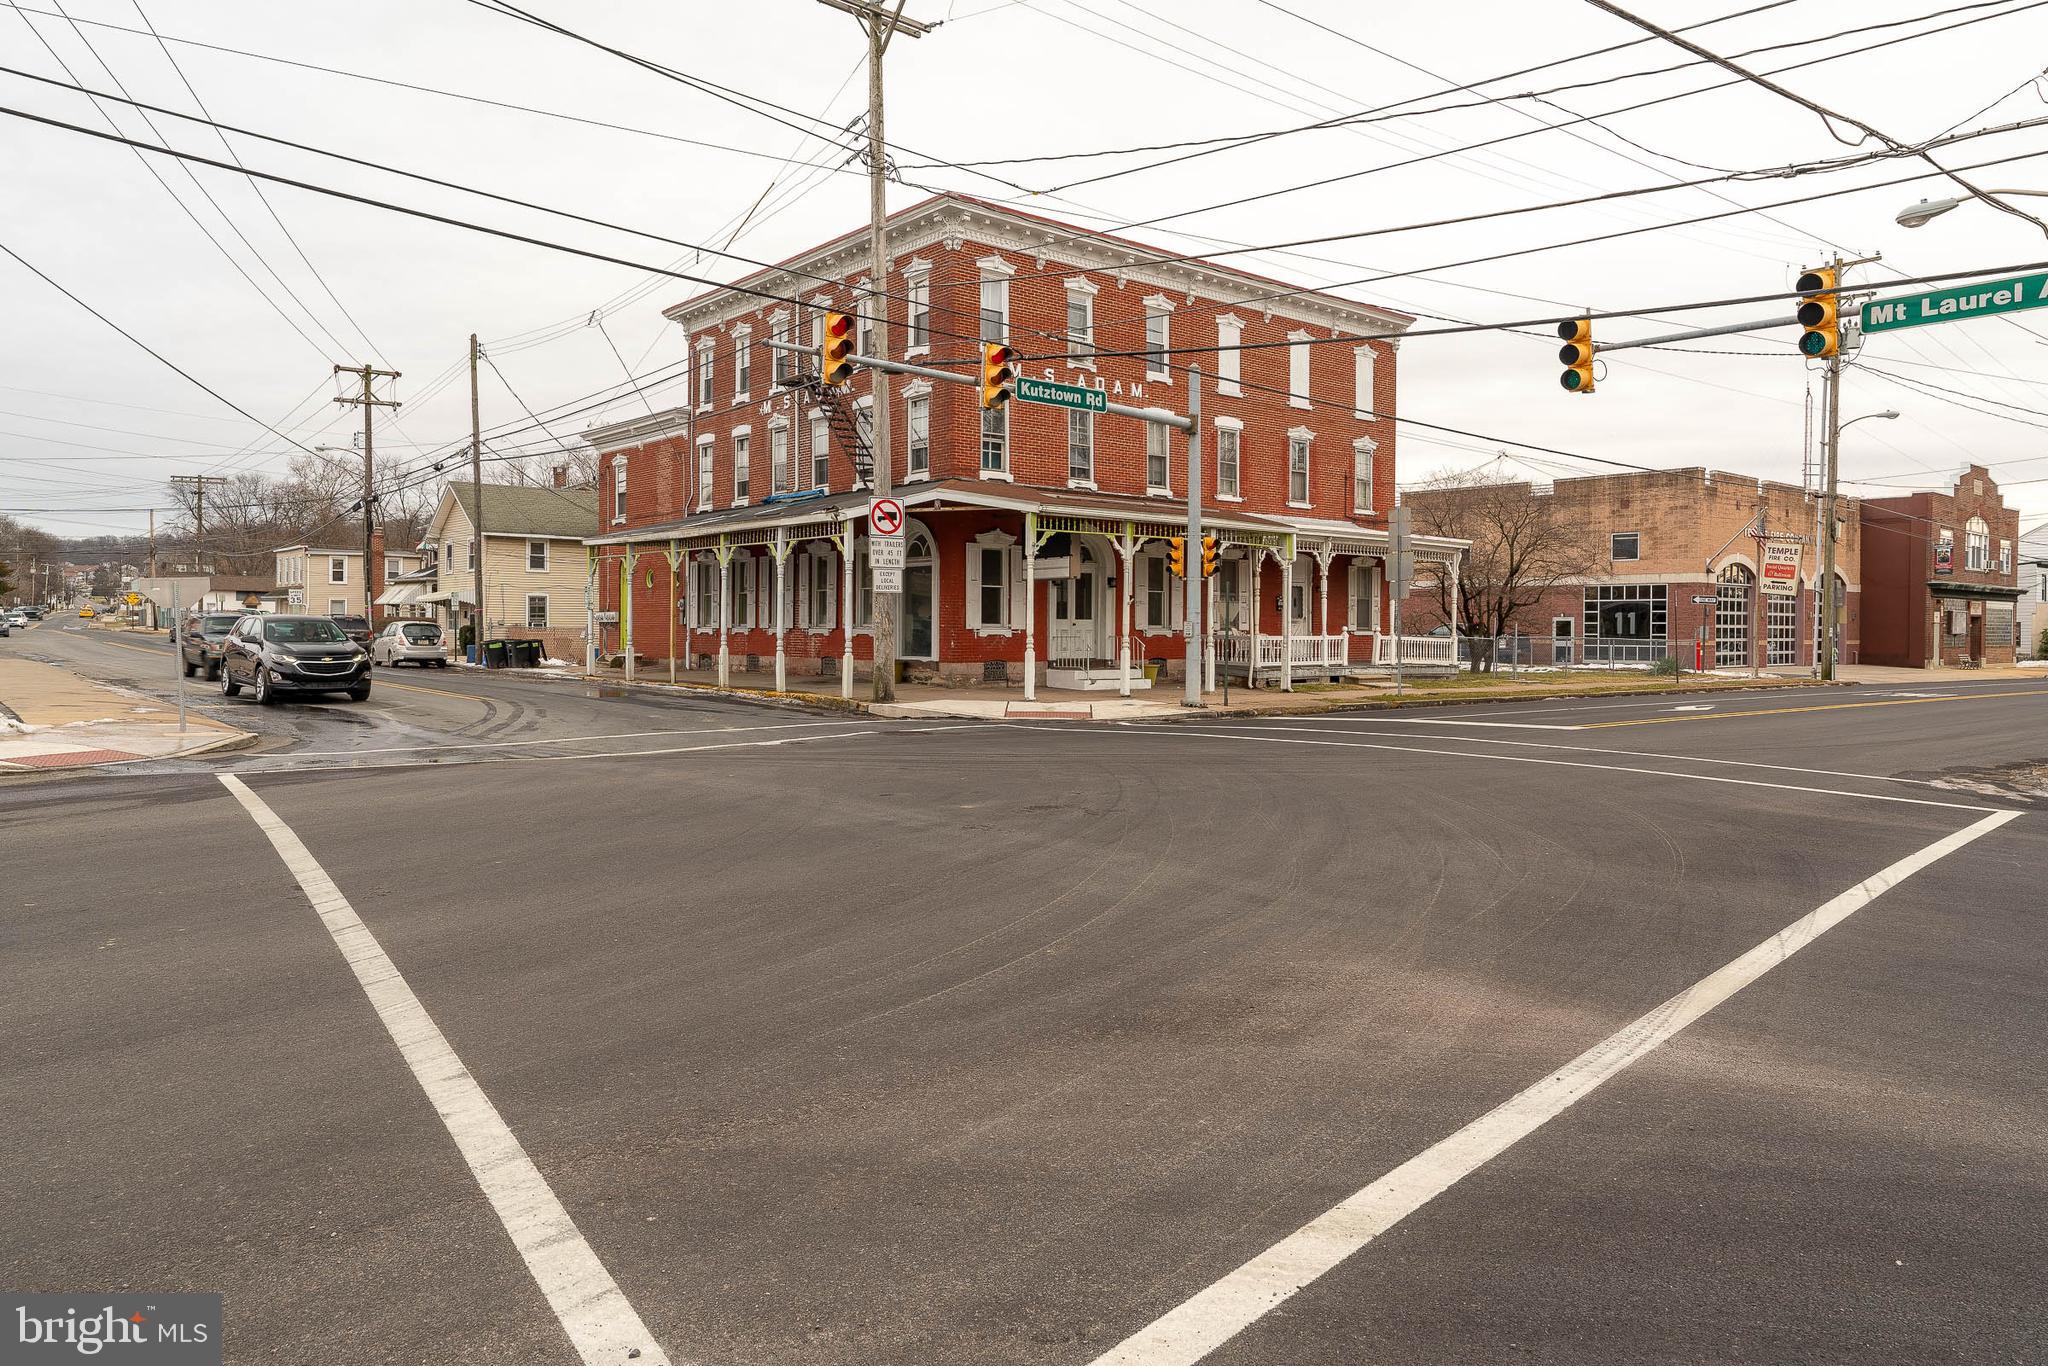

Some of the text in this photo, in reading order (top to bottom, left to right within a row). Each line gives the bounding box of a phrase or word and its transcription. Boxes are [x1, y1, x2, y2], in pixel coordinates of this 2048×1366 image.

[1870, 303, 1907, 325] Mt
[1921, 282, 2024, 317] Laurel
[1020, 382, 1103, 407] Kutztown Rd
[1767, 547, 1799, 556] TEMPLE
[1763, 583, 1793, 591] PARKING
[1614, 611, 1636, 635] 11
